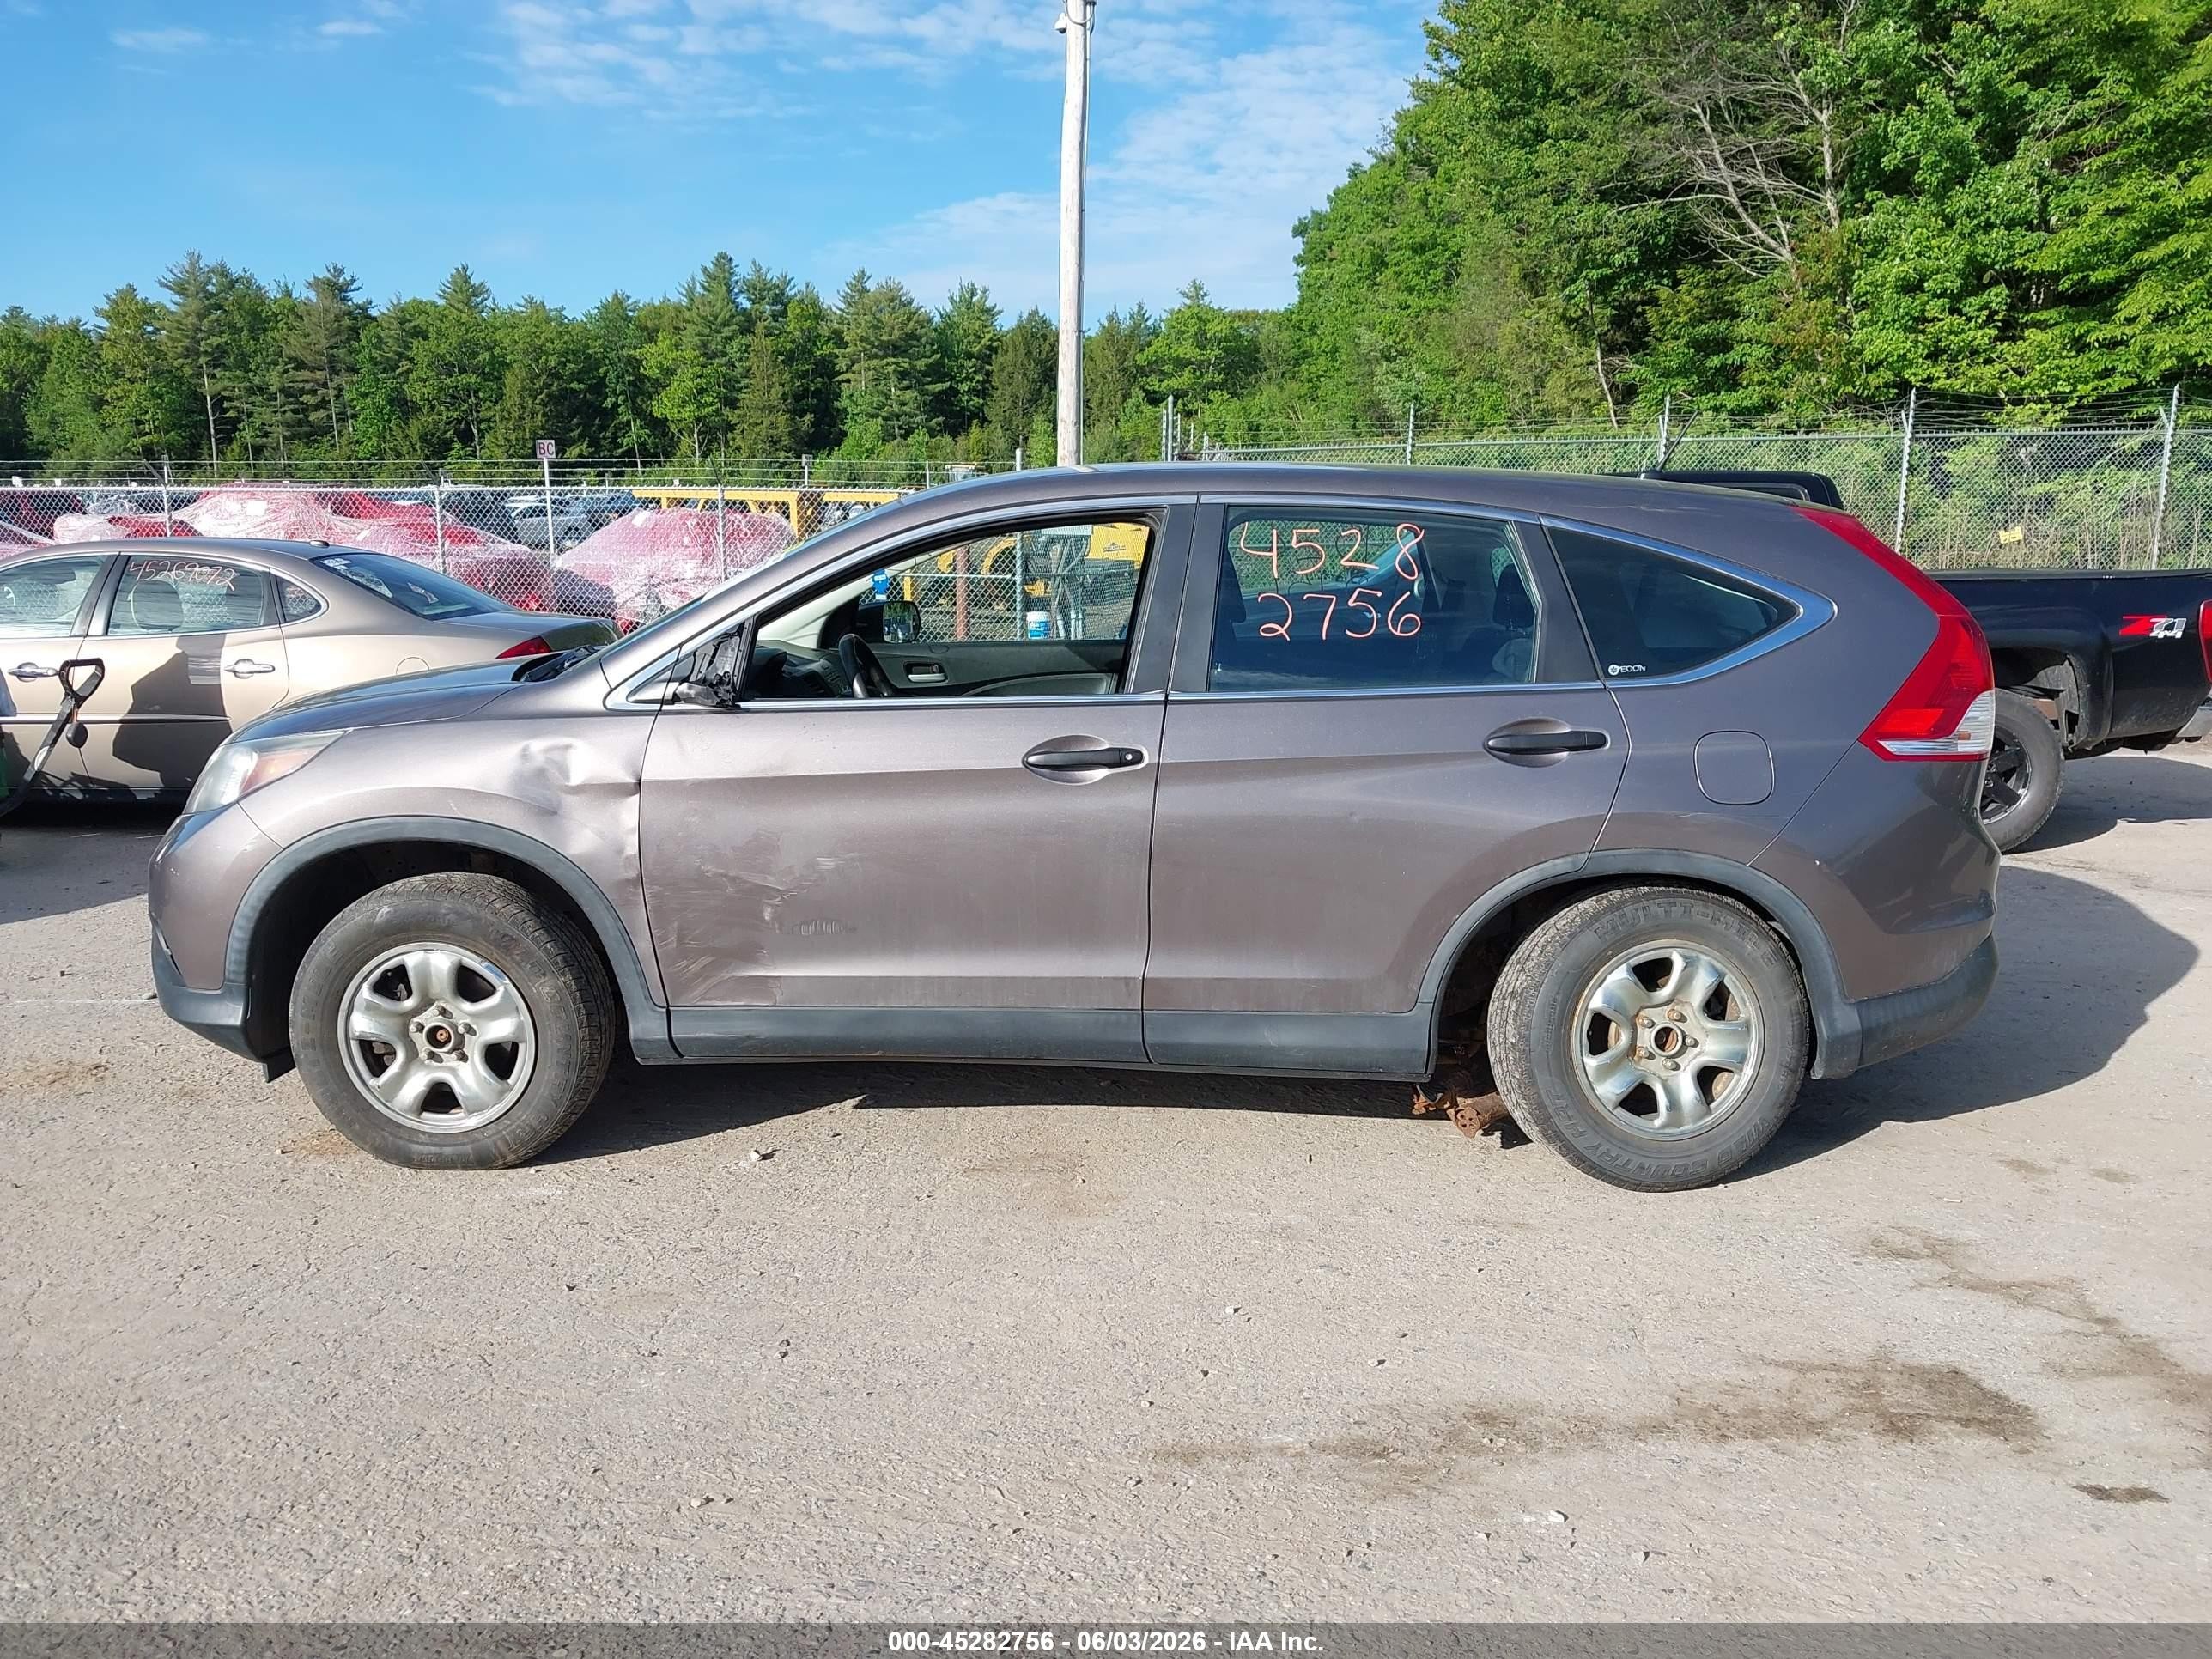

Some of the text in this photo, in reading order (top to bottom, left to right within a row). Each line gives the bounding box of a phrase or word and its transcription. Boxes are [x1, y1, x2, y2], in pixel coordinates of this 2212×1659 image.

[538, 441, 555, 456] BC
[1239, 521, 1425, 580] 4528
[1258, 587, 1422, 641] 2756
[2118, 614, 2187, 637] Z71
[1583, 1142, 1711, 1180] COUNTRY
